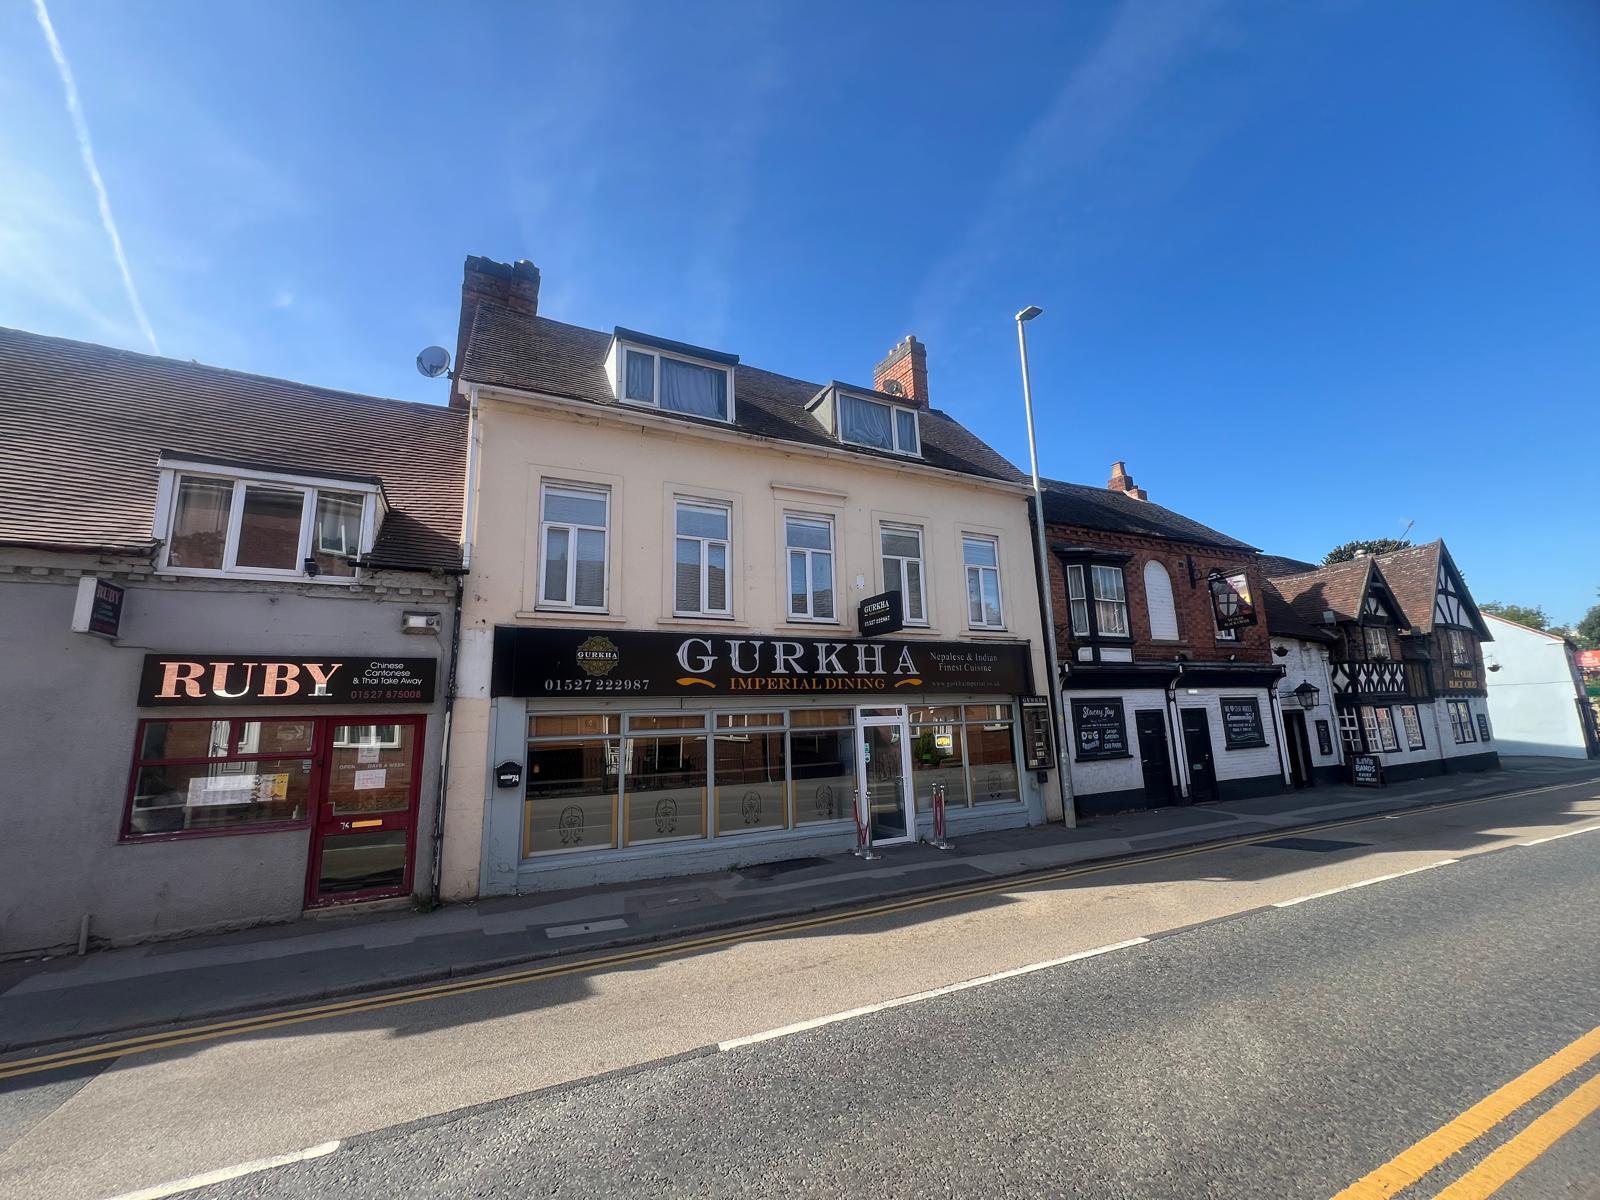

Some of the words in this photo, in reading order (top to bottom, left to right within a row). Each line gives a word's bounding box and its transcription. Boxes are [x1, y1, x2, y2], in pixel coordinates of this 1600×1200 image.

[863, 600, 890, 613] GURKHA
[676, 638, 921, 675] GURKHA
[929, 651, 965, 662] Nepalese
[966, 652, 973, 661] &
[975, 653, 998, 662] Indian
[370, 661, 404, 669] Chinese
[939, 663, 962, 672] Finest
[963, 663, 992, 672] Cuisine
[364, 669, 411, 677] Cantonese
[154, 661, 343, 698] RUBY
[352, 677, 360, 685] &
[361, 677, 379, 685] Thai
[380, 677, 399, 685] Take
[400, 677, 423, 686] Away
[729, 677, 821, 690] IMPERIAL
[825, 678, 886, 690] DINING
[545, 680, 592, 691] 01527
[596, 679, 650, 691] 222987
[351, 690, 383, 699] 01527
[386, 690, 421, 698] 875008
[1082, 706, 1103, 719] Stacey
[1104, 707, 1115, 718] Jay
[1355, 764, 1376, 773] BANDS
[511, 774, 519, 782] 74
